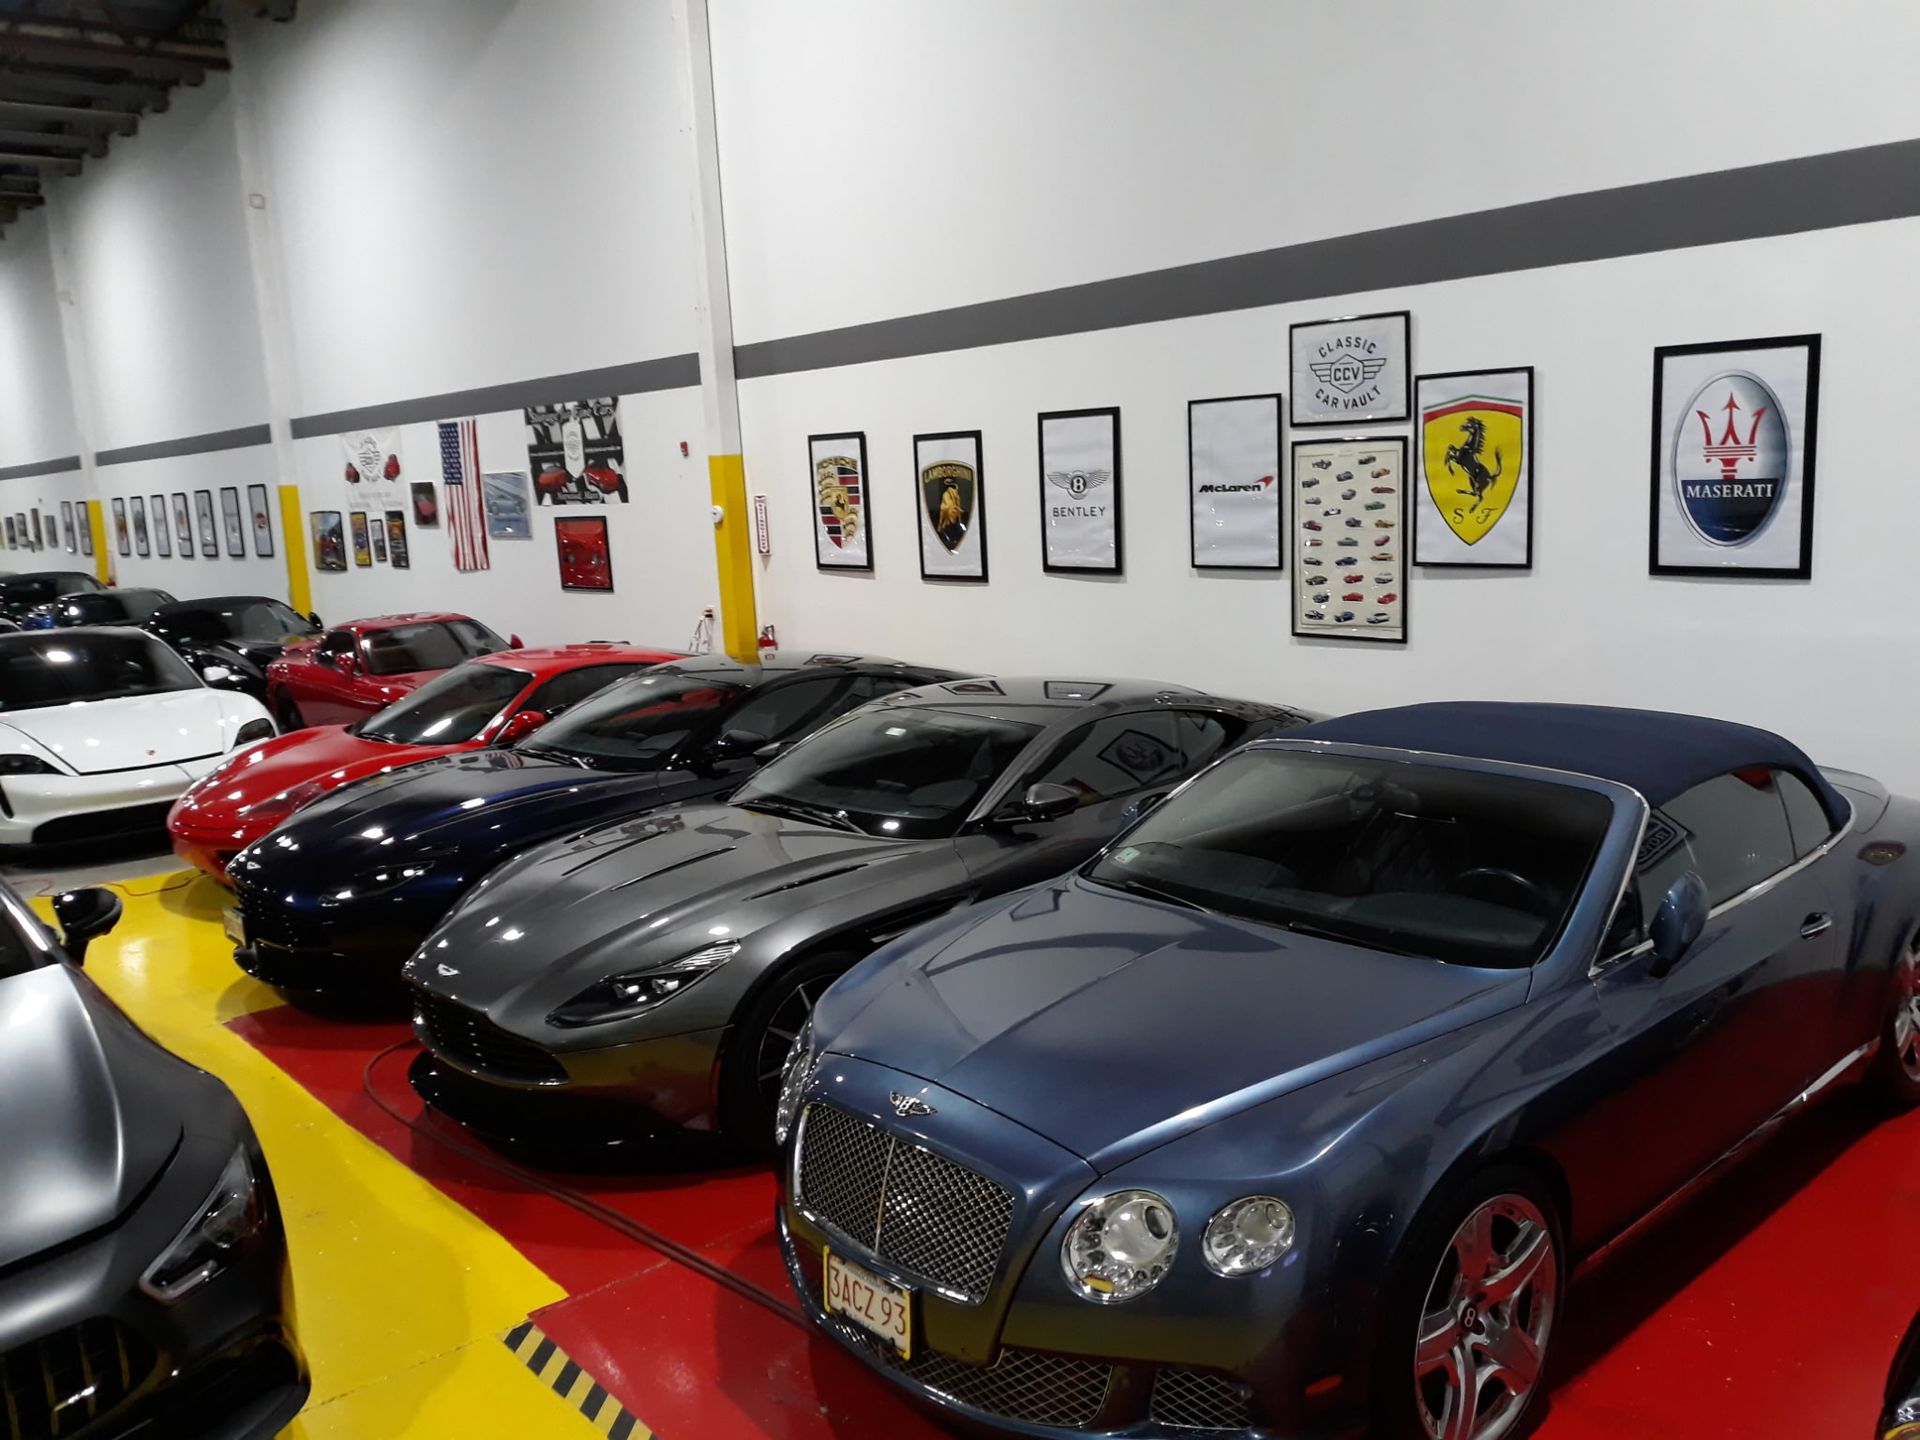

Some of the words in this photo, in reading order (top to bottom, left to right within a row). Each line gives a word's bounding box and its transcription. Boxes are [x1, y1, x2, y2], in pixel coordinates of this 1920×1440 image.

[1318, 336, 1377, 358] CLASSIC
[1333, 366, 1360, 382] CCV
[1315, 388, 1339, 409] CAR
[1343, 385, 1381, 410] VAULT
[1199, 484, 1262, 493] McLaren
[1686, 484, 1773, 498] MASERATI
[1052, 506, 1106, 517] BENTLEY
[1453, 507, 1464, 524] S
[830, 1265, 875, 1321] 3ACZ
[881, 1296, 906, 1336] 93
